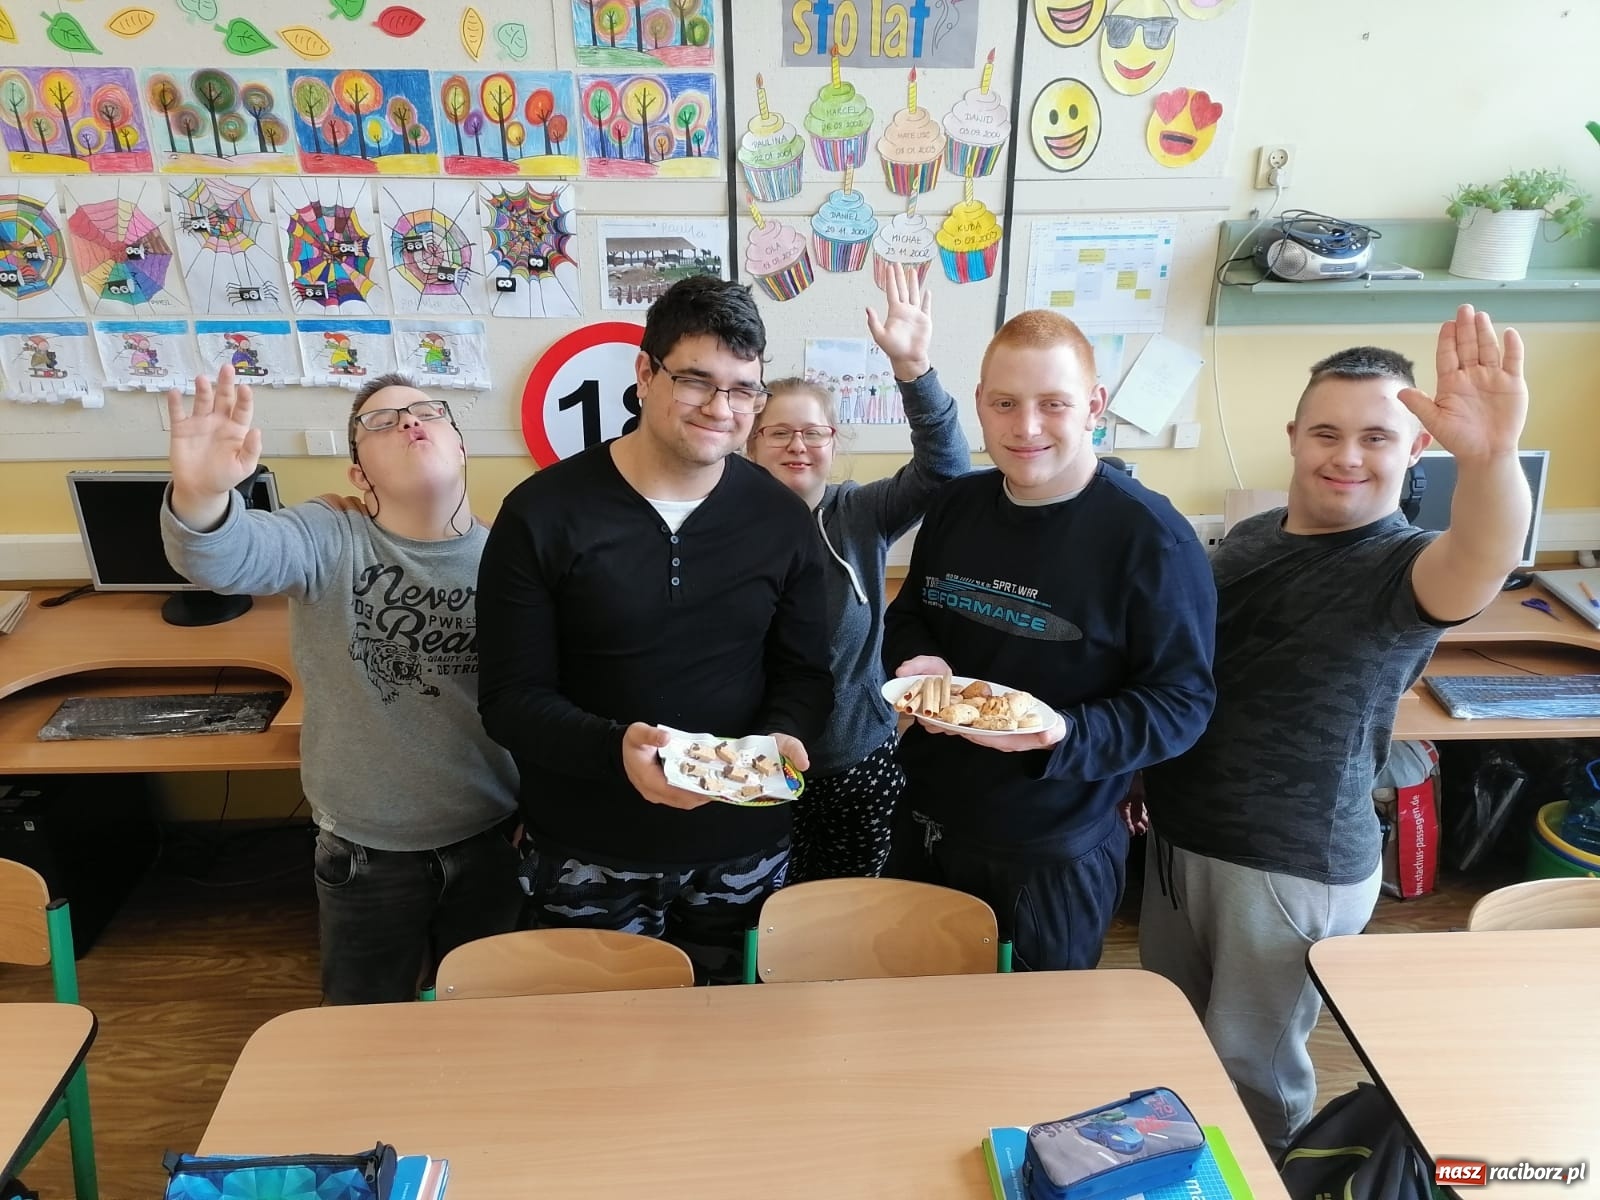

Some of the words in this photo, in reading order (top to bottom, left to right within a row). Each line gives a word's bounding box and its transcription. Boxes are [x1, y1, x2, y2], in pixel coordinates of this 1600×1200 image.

[752, 134, 788, 149] PAULINA
[831, 211, 859, 221] DANIEL
[957, 223, 983, 233] KUBA
